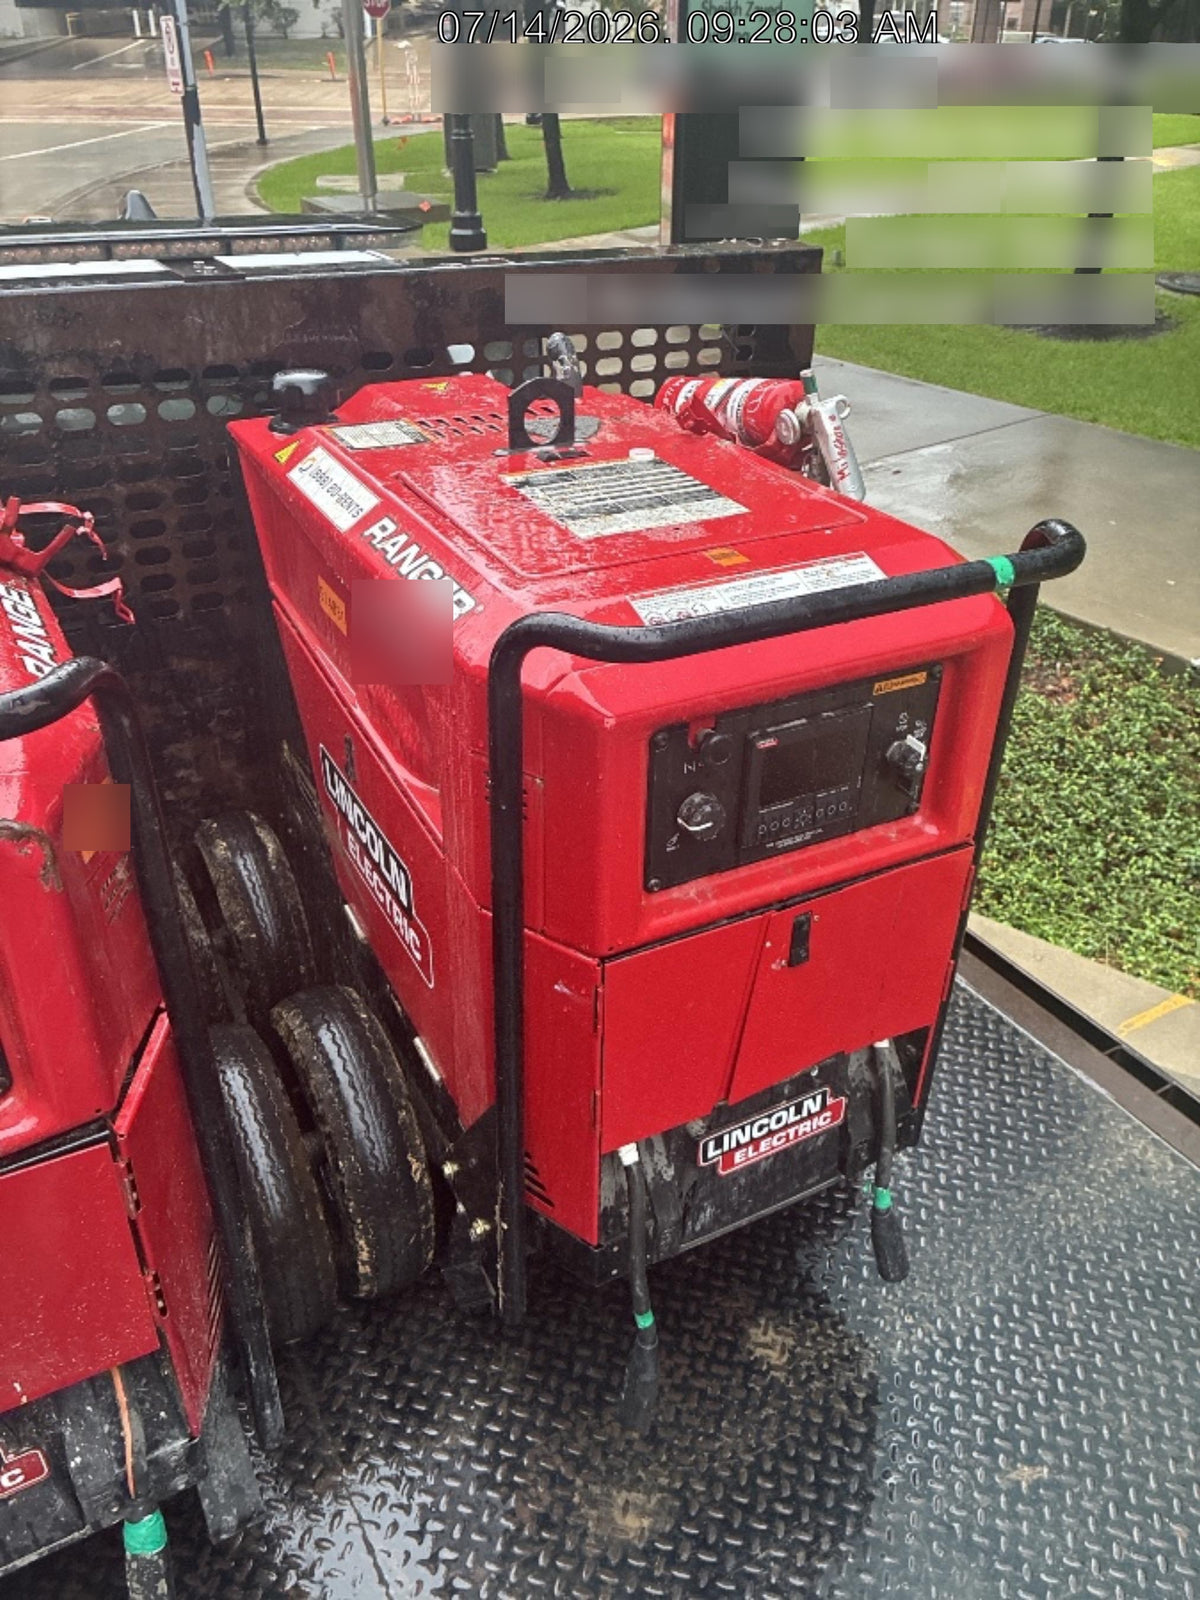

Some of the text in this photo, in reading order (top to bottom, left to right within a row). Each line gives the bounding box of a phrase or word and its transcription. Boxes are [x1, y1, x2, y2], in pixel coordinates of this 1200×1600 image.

[325, 757, 408, 908] LINCOLN
[347, 829, 422, 962] ELECTRIC
[707, 1094, 823, 1160] LINCOLN
[734, 1111, 833, 1165] ELECTRIC
